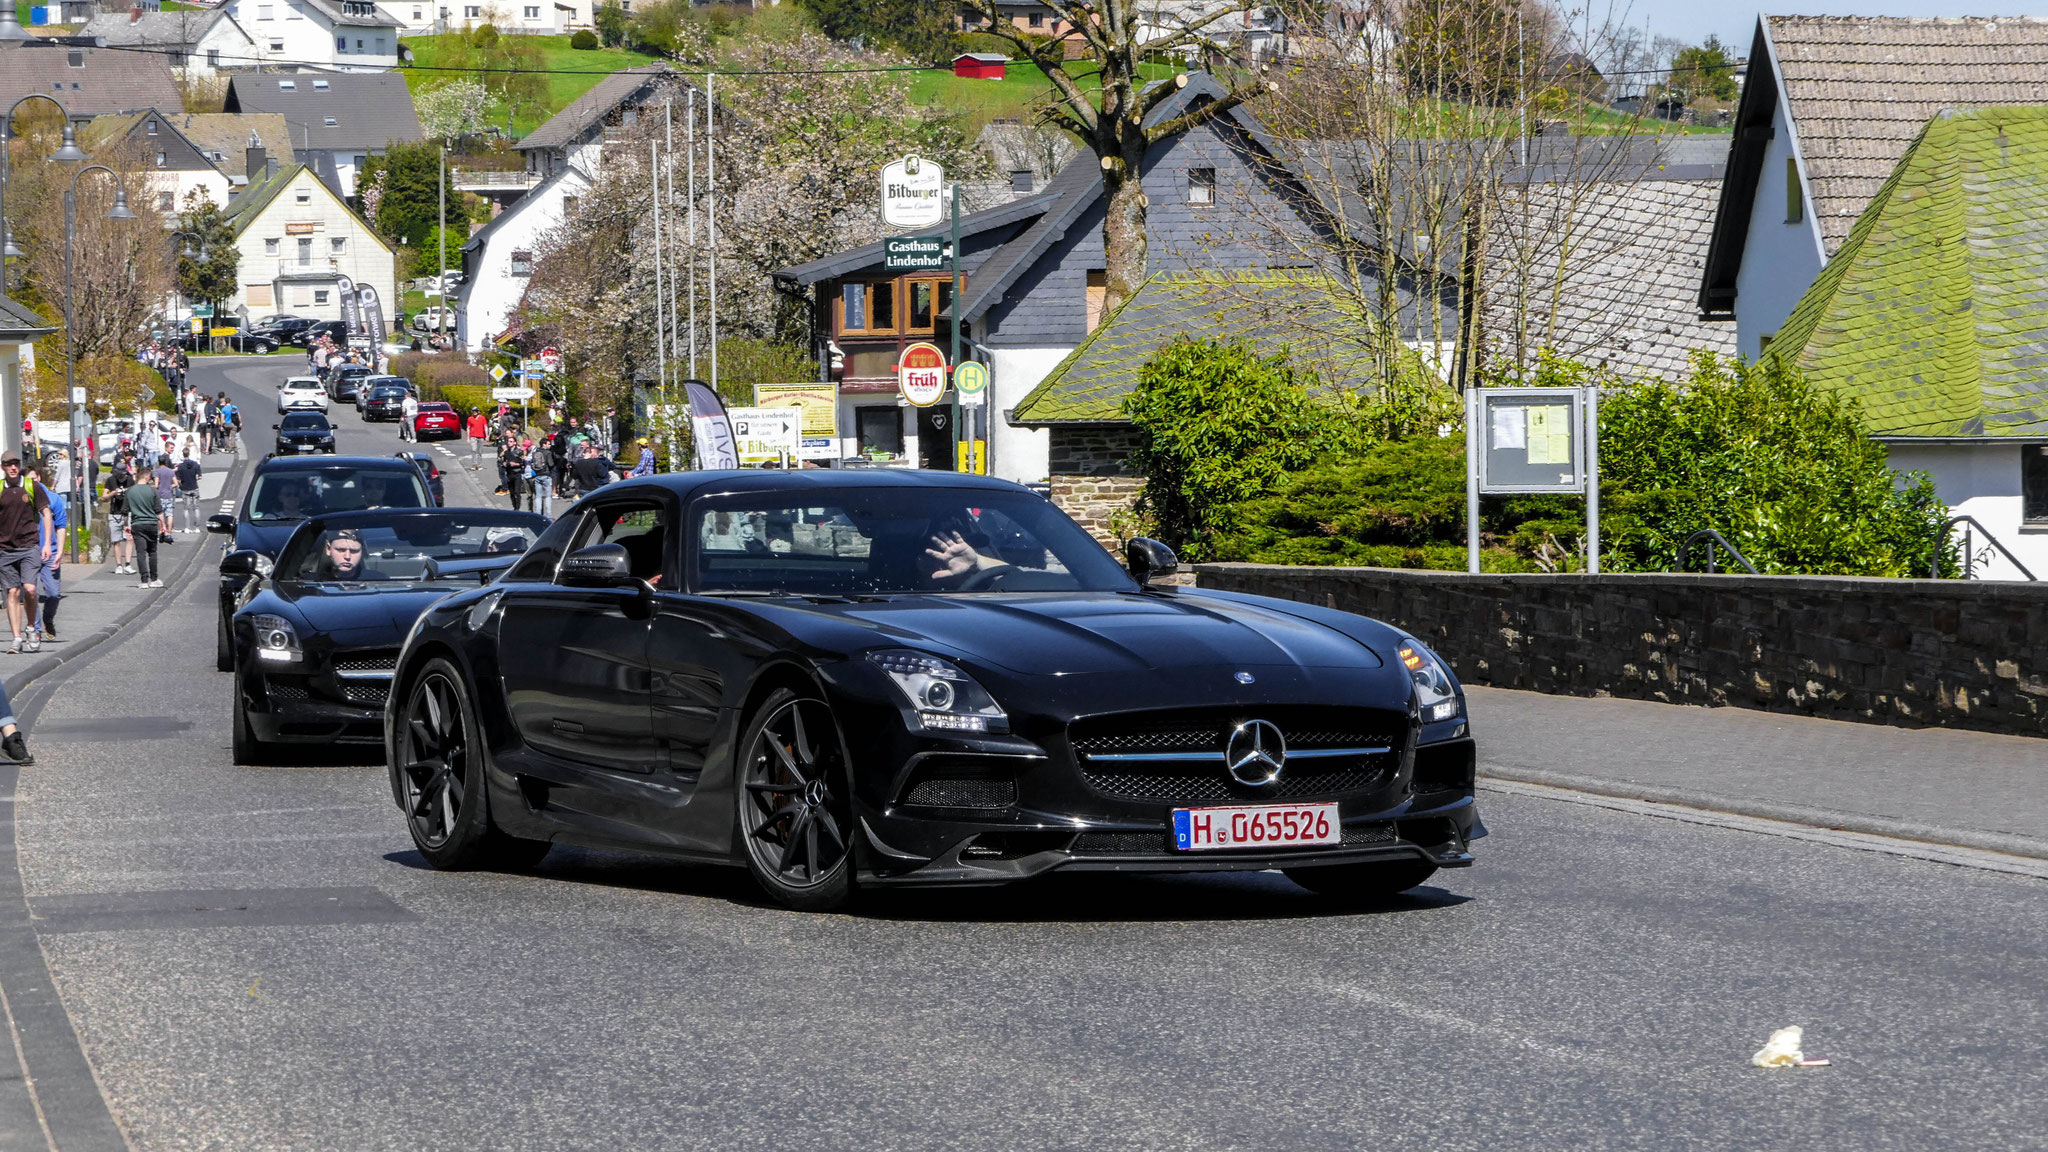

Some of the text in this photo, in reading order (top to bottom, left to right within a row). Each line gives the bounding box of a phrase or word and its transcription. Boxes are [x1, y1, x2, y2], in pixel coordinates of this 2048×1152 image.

[888, 184, 939, 200] Bitburger
[889, 241, 940, 252] Gasthaus
[887, 254, 943, 267] Lindenhof
[907, 372, 938, 388] früh
[964, 370, 978, 387] H
[762, 411, 794, 419] Lindenhof
[1193, 810, 1330, 844] H 065526
[1179, 833, 1187, 842] D
